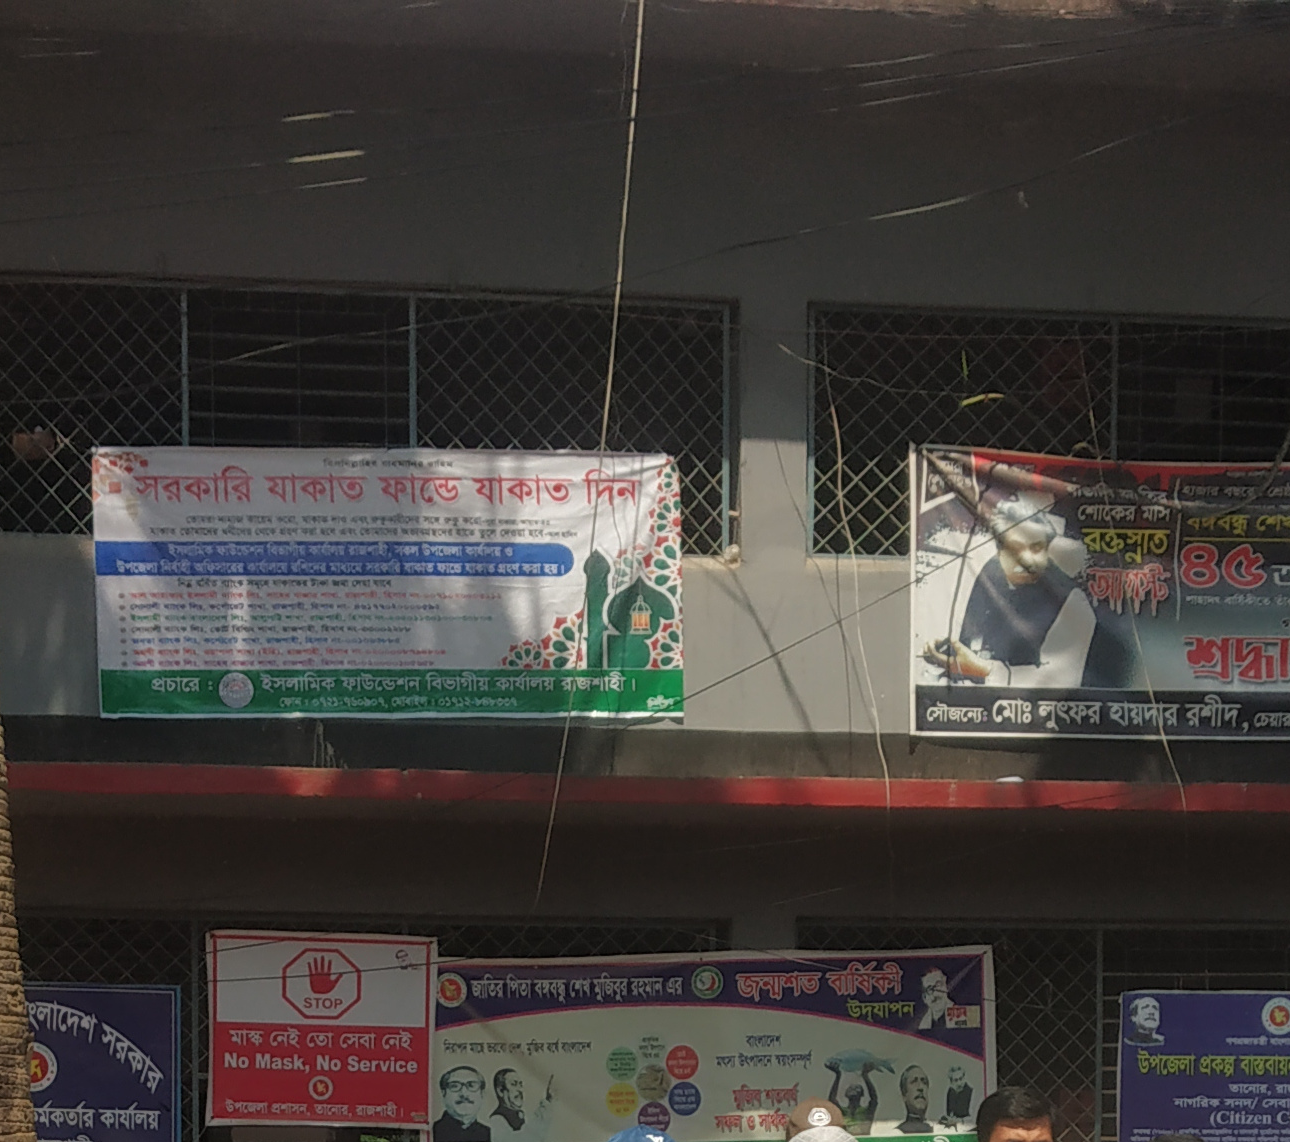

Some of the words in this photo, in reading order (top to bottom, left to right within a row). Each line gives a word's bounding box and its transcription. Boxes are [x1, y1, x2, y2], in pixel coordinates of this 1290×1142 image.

[133, 464, 254, 502] সরকারি
[264, 473, 366, 503] যাকাত
[376, 474, 461, 504] ফান্ডে
[470, 474, 571, 505] যাকাত
[582, 469, 638, 505] দিন
[1076, 503, 1137, 523] শোকের
[1140, 503, 1172, 521] মাস
[1181, 541, 1265, 586] ৪৫
[1087, 564, 1171, 612] আগস্ট
[258, 671, 336, 693] ইসলামিক
[339, 671, 422, 691] ফাউন্ডেশন
[424, 672, 490, 691] বিভাগীয়
[493, 672, 556, 691] কার্যালয়
[992, 697, 1032, 724] মোঃ
[1037, 700, 1102, 731] লুৎফর
[1106, 698, 1180, 728] হায়দার
[470, 974, 504, 998] জাতির
[507, 974, 532, 999] পিতা
[534, 979, 566, 1003] বঙ্গবন্ধু
[568, 976, 591, 998] শেখ
[591, 971, 628, 1002] মুজিবুর
[629, 976, 663, 1004] রহমান
[665, 976, 685, 1004] এর
[734, 967, 824, 1003] জন্মশত
[822, 959, 904, 997] বার্ষিকী
[303, 997, 343, 1010] STOP
[228, 1028, 264, 1046] মাস্ক
[268, 1026, 301, 1048] নেই
[305, 1031, 334, 1048] তো
[338, 1032, 376, 1049] সেবা
[381, 1028, 413, 1051] নেই
[100, 1021, 164, 1094] সরকার
[223, 1051, 249, 1068] No
[315, 1054, 341, 1071] No
[346, 1055, 418, 1073] Service
[1138, 1050, 1196, 1077] উপজেলা
[1199, 1054, 1235, 1078] প্রকল্প
[97, 1101, 161, 1130] কার্যালয়
[224, 1099, 268, 1114] উপজেলা
[1210, 1110, 1273, 1126] (Citizen
